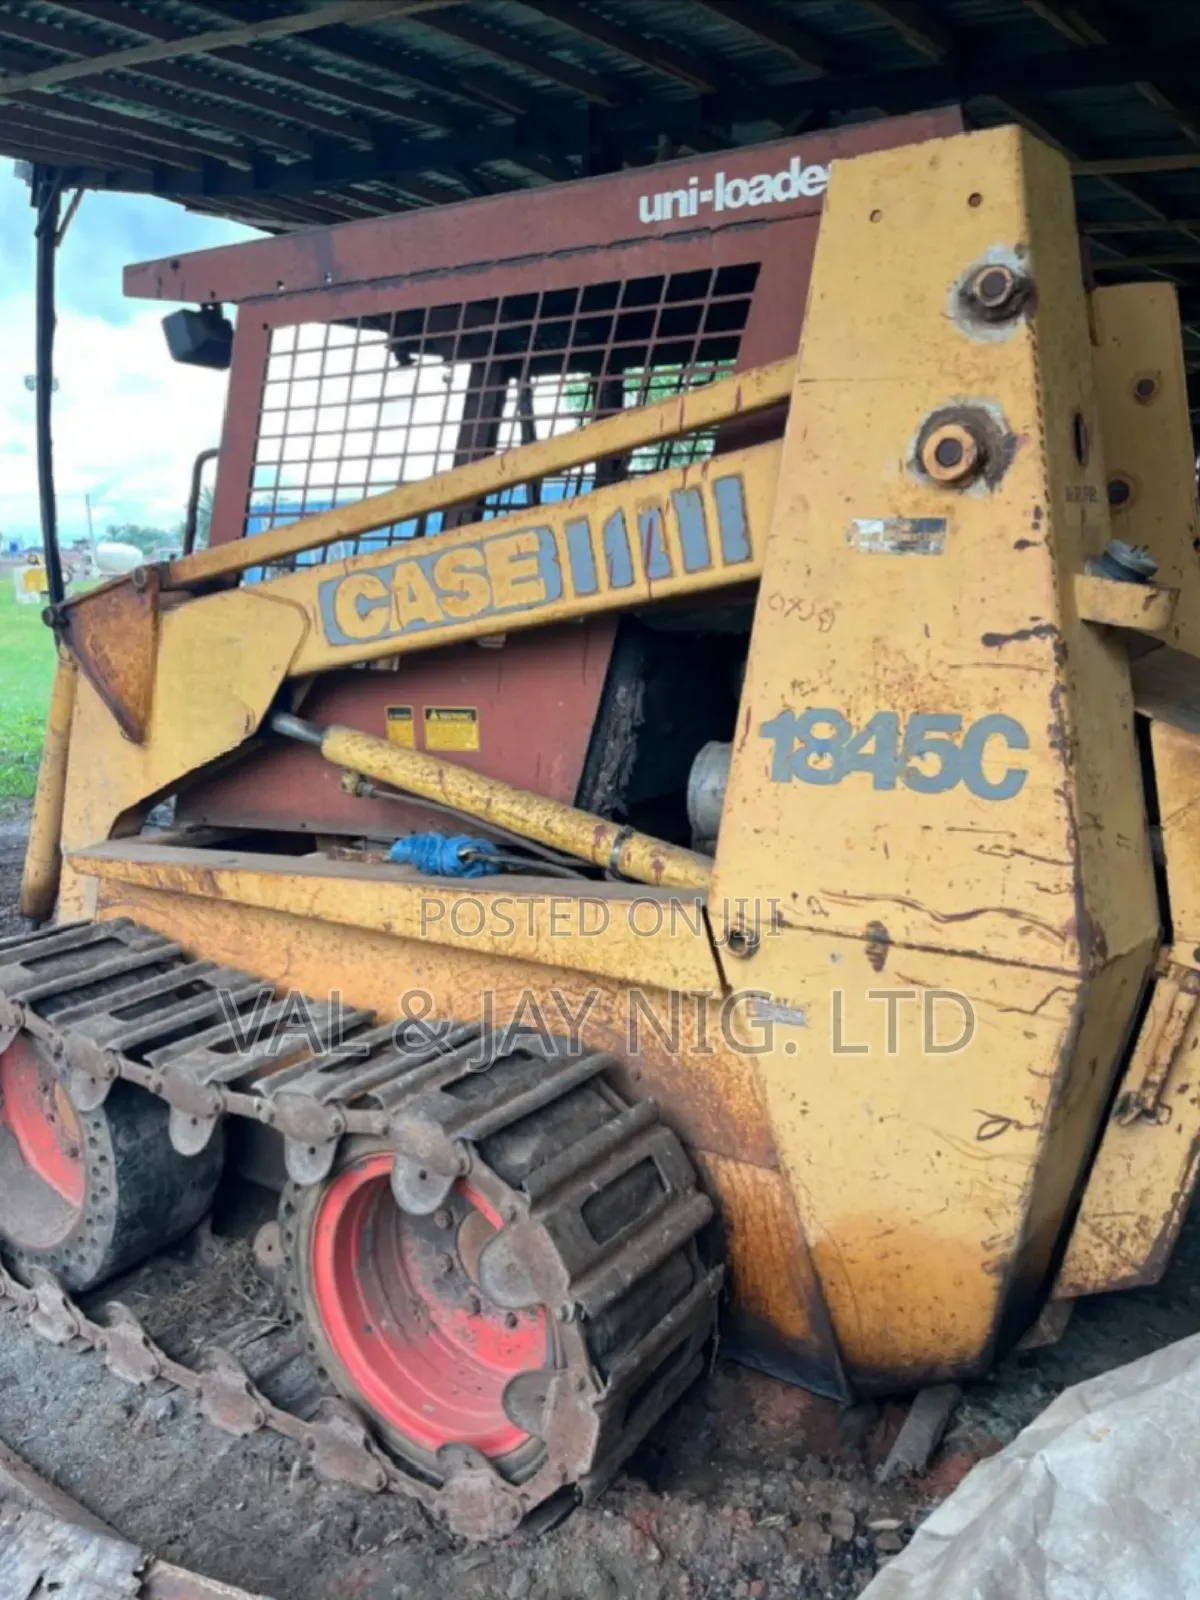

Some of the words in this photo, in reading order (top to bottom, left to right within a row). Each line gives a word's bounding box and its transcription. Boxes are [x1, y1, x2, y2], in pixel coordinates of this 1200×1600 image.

[639, 156, 832, 223] uni-loade
[334, 529, 546, 638] CASE
[759, 708, 1030, 801] 1845C
